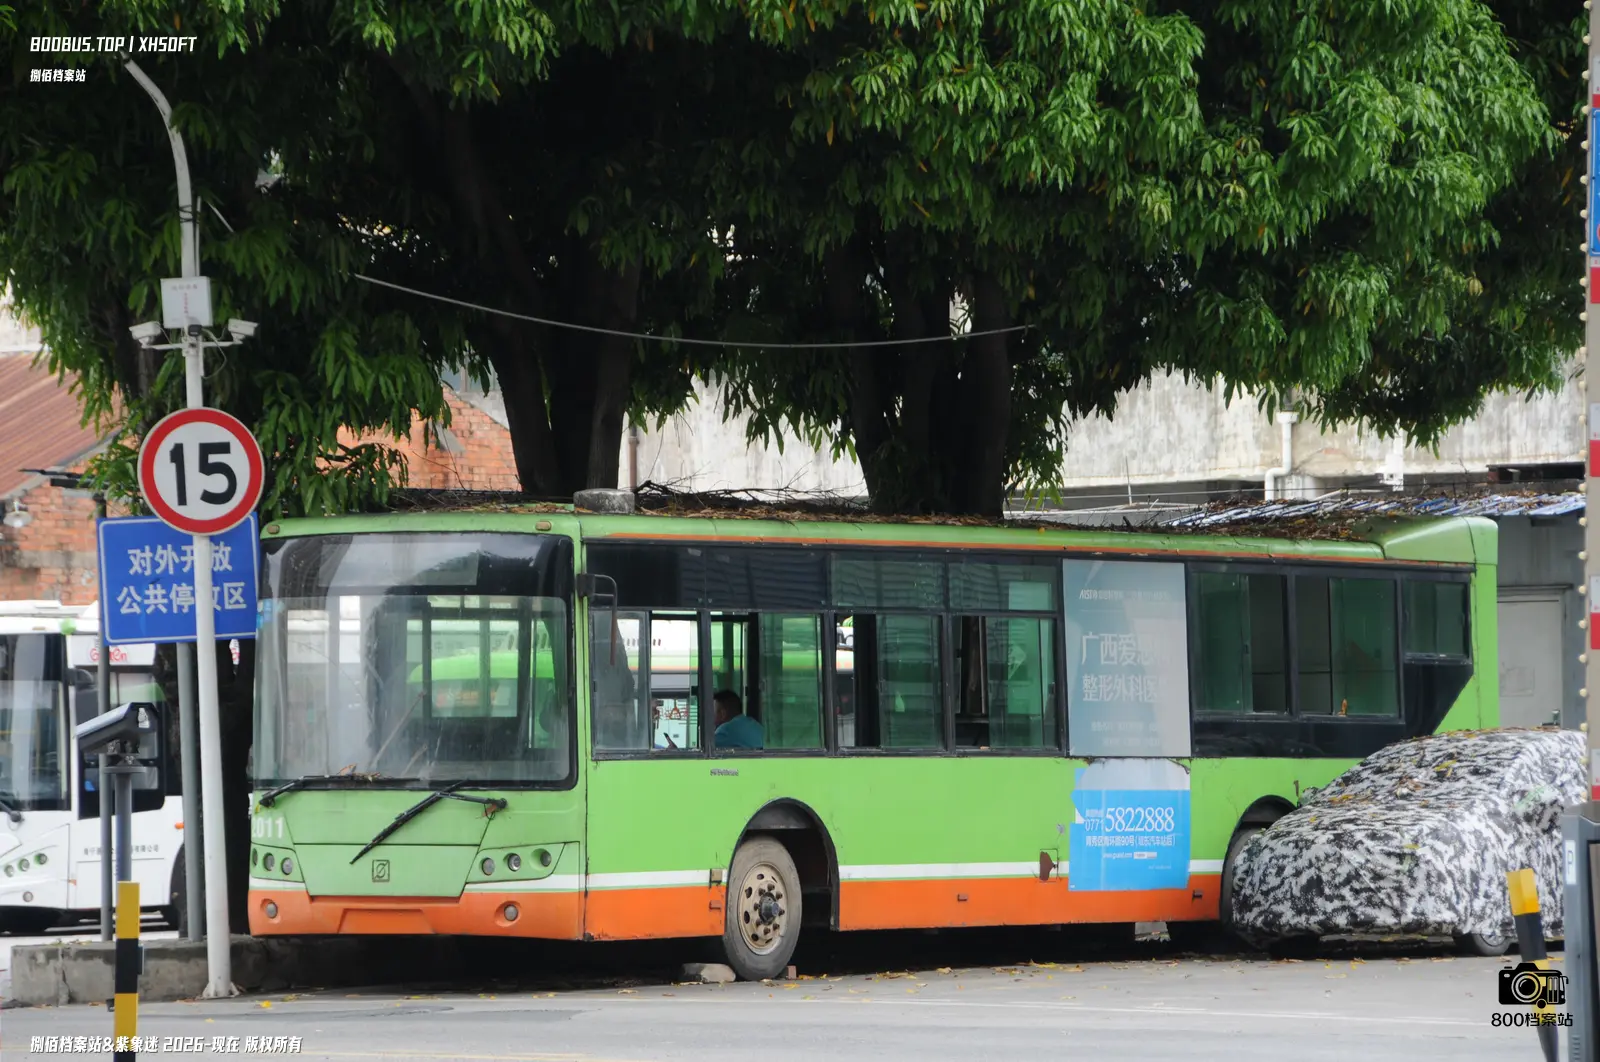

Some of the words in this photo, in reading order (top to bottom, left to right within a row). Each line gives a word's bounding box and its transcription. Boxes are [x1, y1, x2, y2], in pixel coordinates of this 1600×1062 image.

[169, 441, 237, 506] 15
[1082, 673, 1171, 703] 整形外科医
[1104, 806, 1175, 833] 5822888
